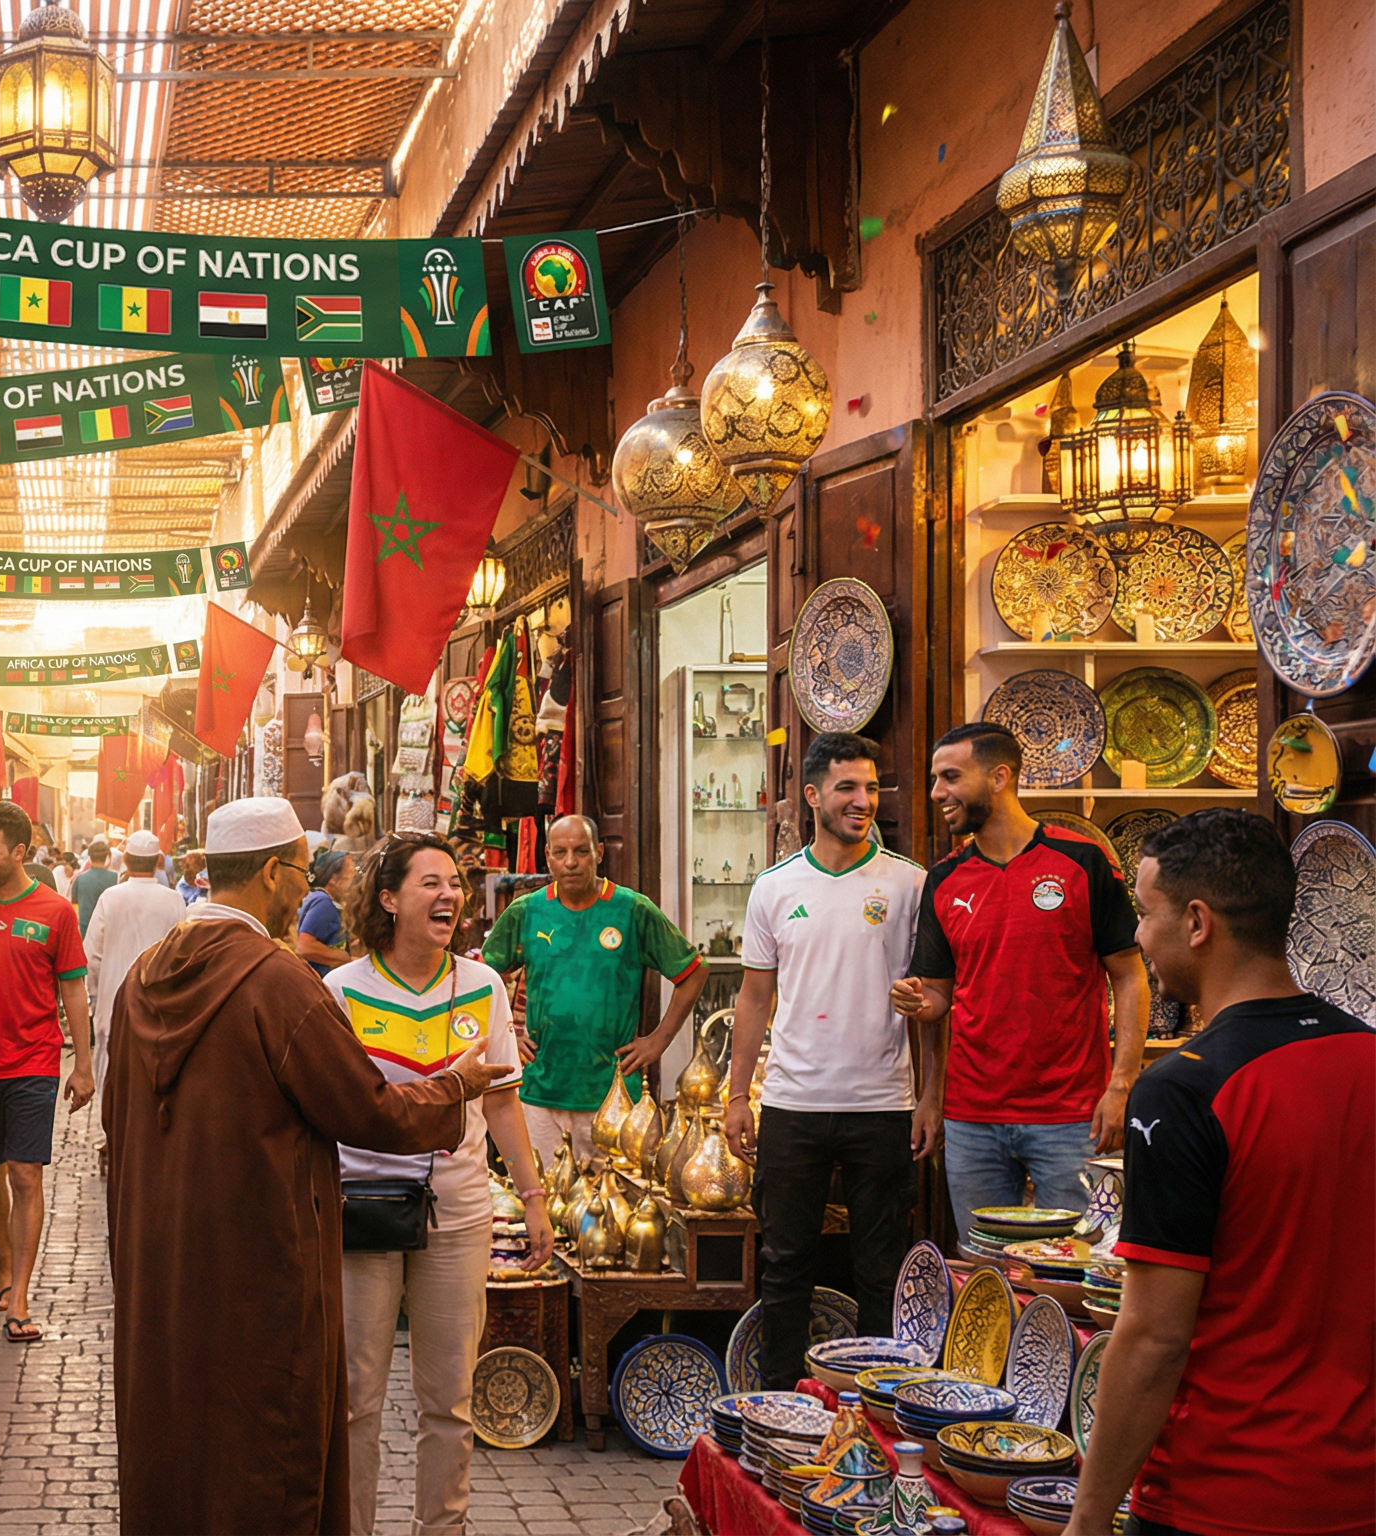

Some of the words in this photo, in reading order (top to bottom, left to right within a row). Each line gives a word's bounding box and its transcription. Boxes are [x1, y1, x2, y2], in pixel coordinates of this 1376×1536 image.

[50, 238, 126, 272] CUP
[136, 245, 187, 275] OF
[198, 249, 360, 282] NATIONS
[3, 386, 43, 410] OF
[52, 364, 186, 404] NATIONS
[18, 558, 52, 573] CUP
[54, 559, 78, 573] OF
[81, 558, 152, 573] NATIONS
[6, 658, 46, 670] AFRICA
[48, 658, 70, 669] CUP
[71, 656, 87, 668] OF
